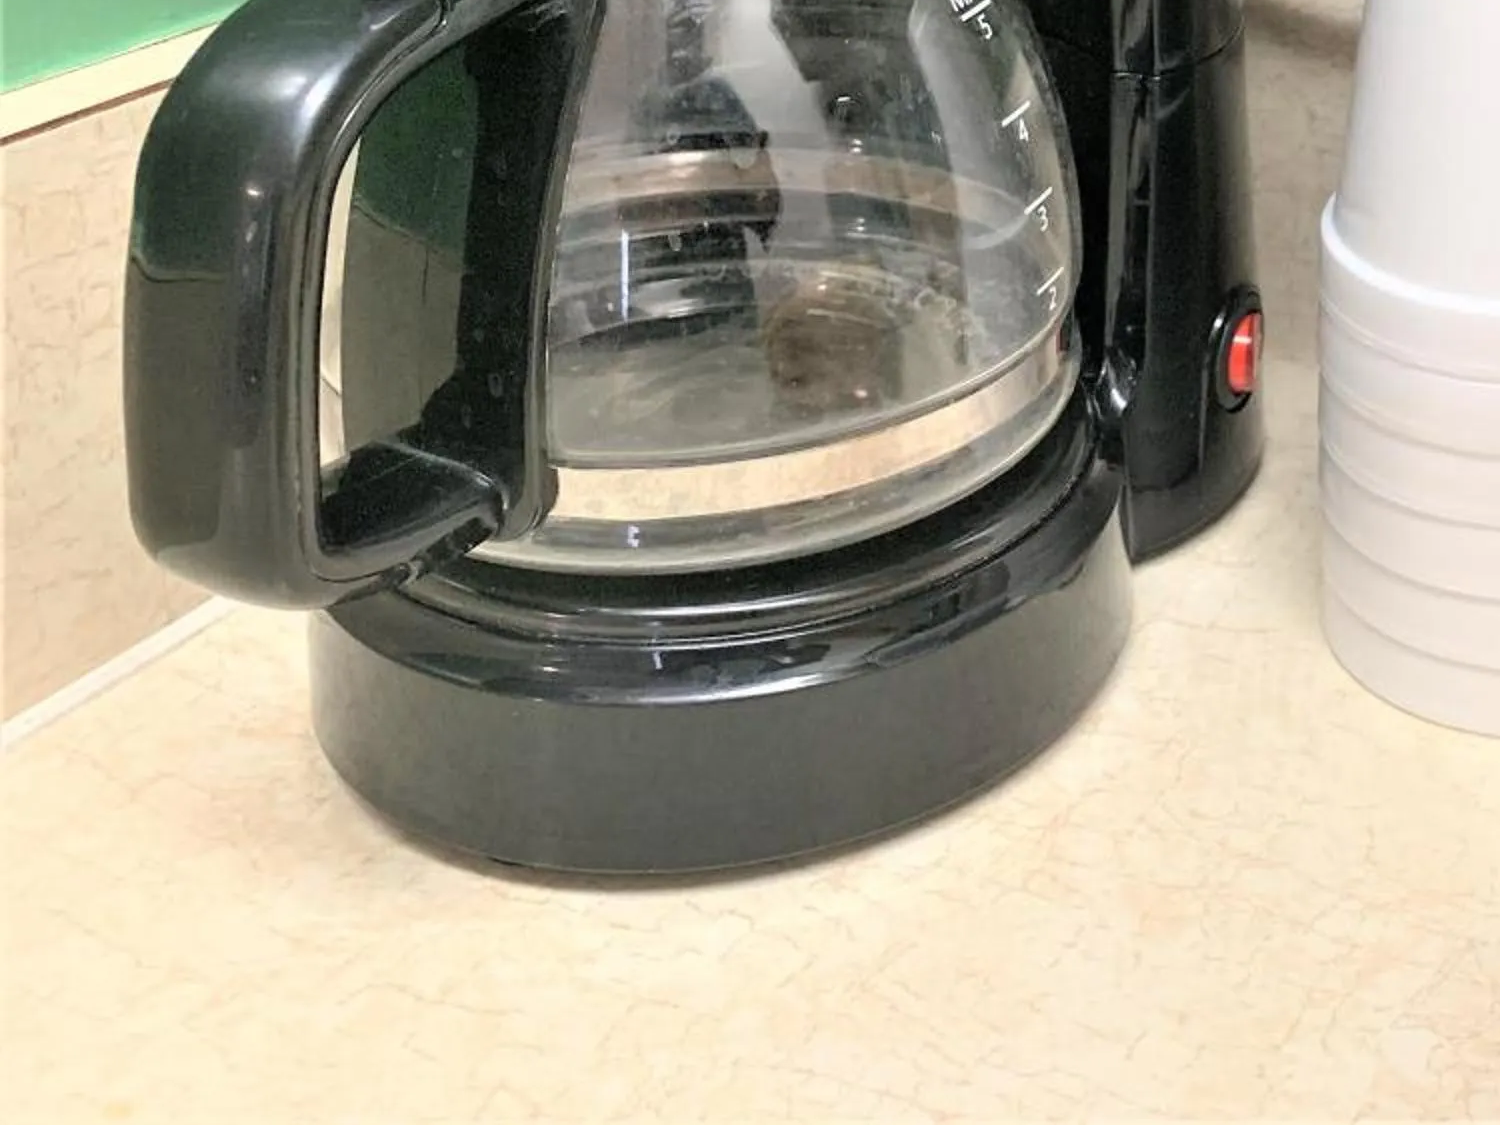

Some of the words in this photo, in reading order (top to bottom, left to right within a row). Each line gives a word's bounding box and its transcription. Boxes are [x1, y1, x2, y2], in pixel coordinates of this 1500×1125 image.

[977, 13, 993, 40] 5
[1018, 118, 1030, 142] 4
[1036, 205, 1049, 232] 3
[1048, 286, 1058, 311] 2
